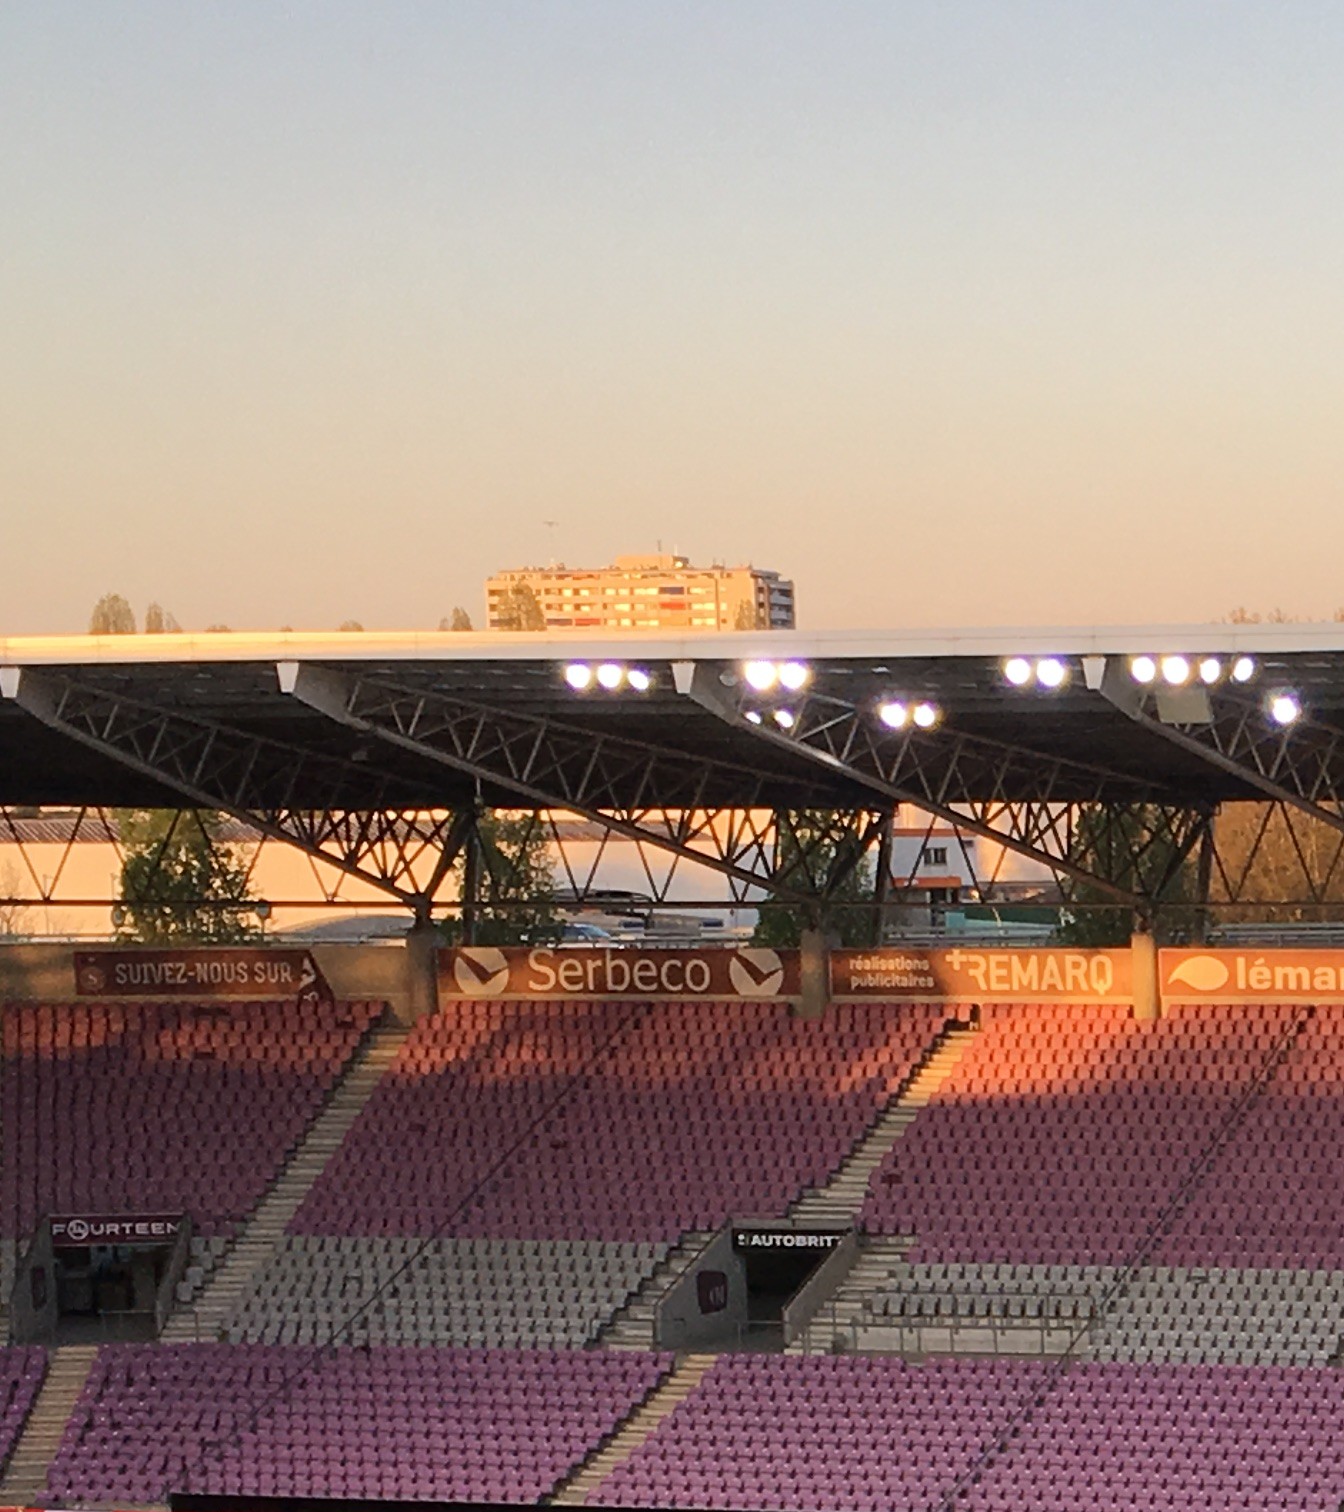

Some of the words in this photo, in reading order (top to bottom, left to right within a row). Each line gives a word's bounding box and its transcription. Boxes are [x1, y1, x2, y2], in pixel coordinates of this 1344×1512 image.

[114, 962, 248, 984] SUIVEZ-NOUS
[254, 963, 292, 983] SUR
[527, 949, 711, 992] Serbeco
[849, 955, 929, 971] réalisations
[851, 973, 934, 991] publicitaires
